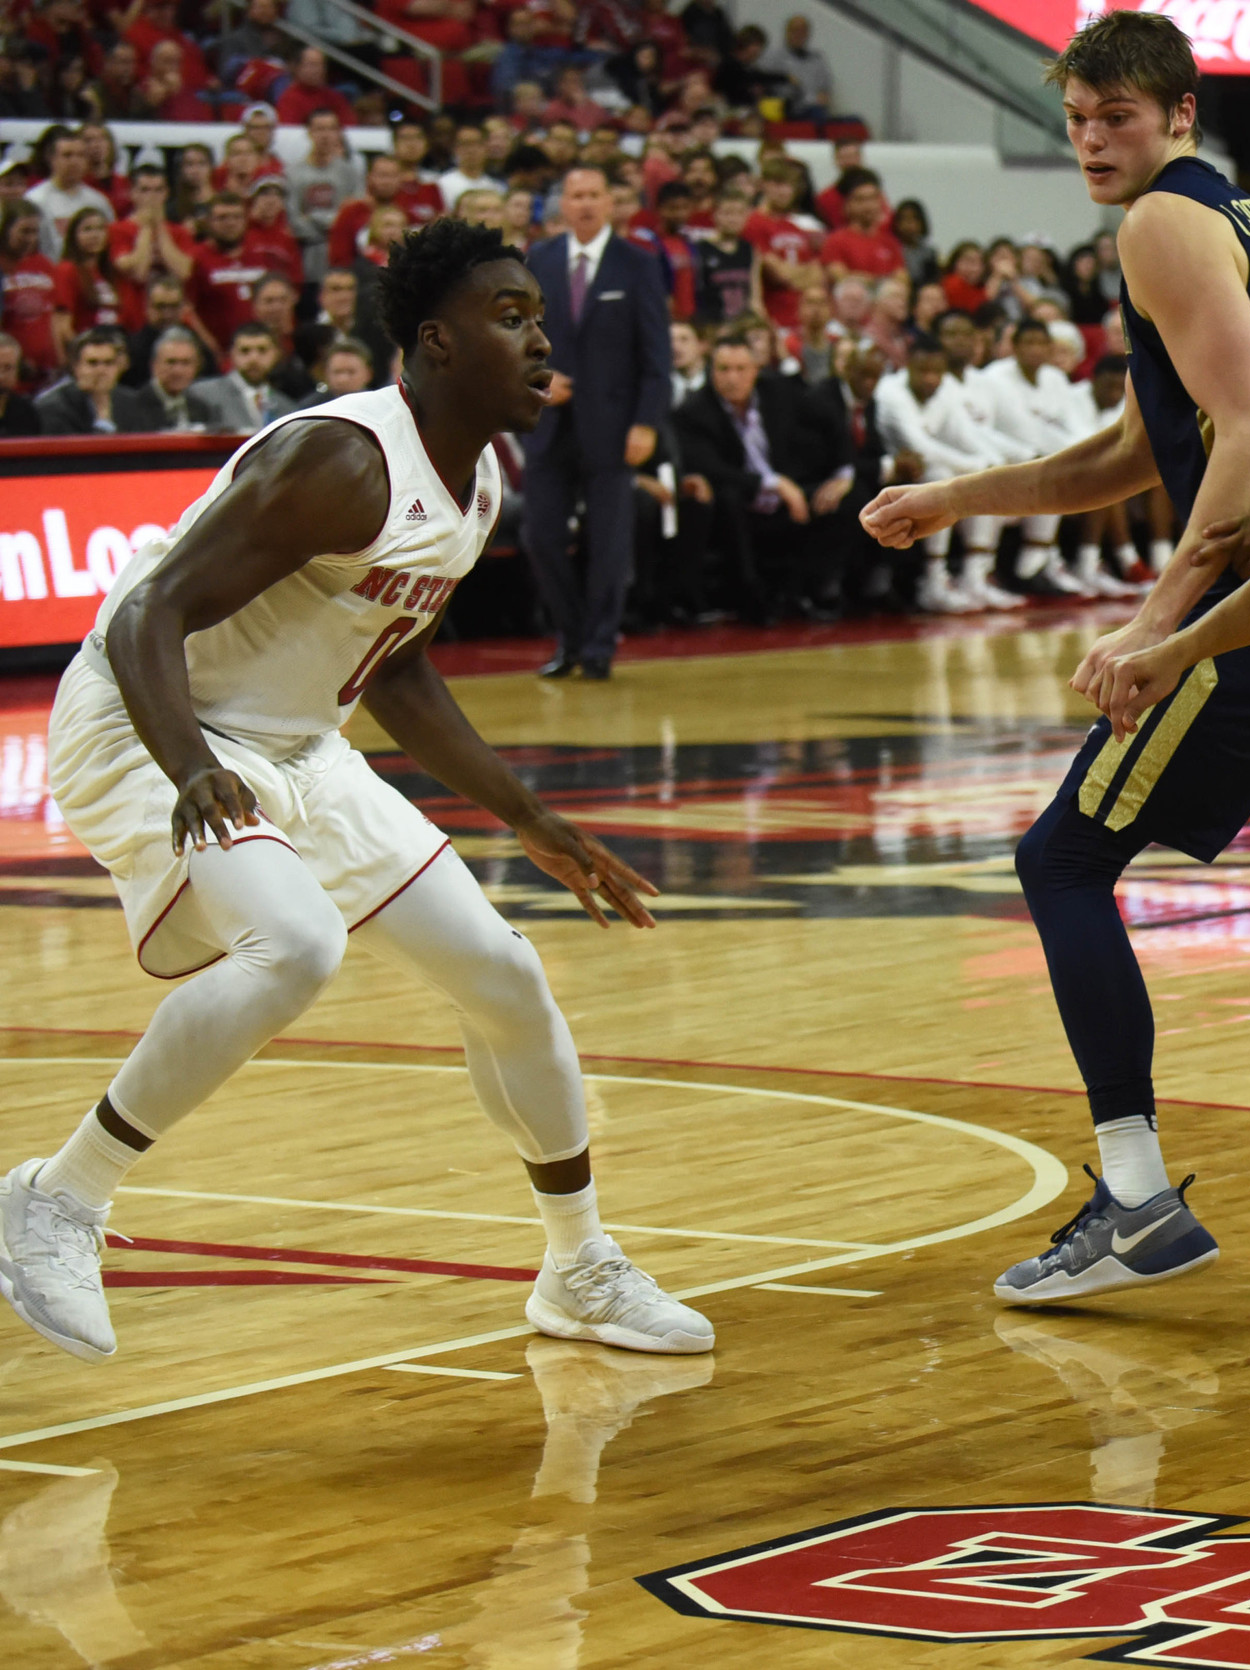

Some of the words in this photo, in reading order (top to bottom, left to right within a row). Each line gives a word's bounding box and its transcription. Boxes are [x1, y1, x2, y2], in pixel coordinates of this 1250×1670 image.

[405, 513, 428, 521] adidas
[350, 565, 411, 607] NC
[338, 616, 418, 707] 0
